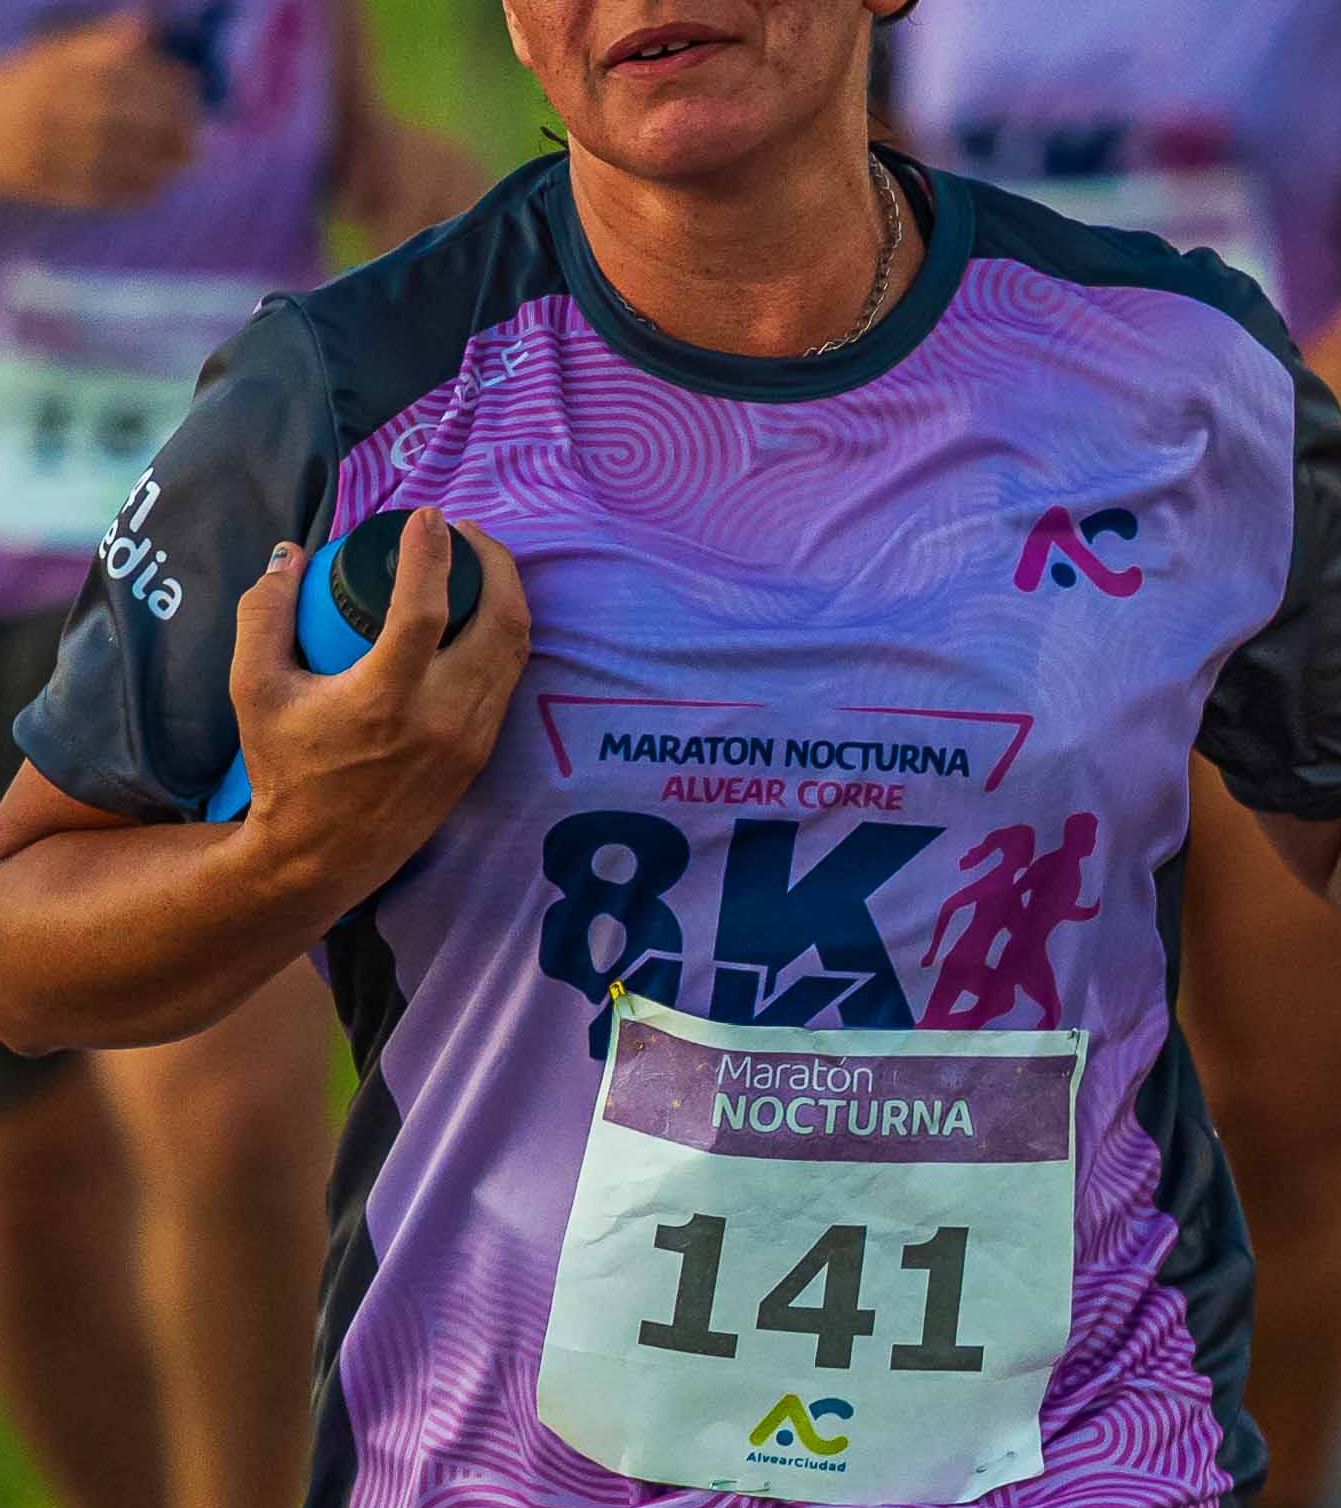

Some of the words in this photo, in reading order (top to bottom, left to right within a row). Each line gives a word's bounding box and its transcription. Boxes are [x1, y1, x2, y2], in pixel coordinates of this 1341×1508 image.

[598, 732, 774, 767] MARATON
[784, 738, 970, 777] NOCTURNA
[660, 775, 787, 808] ALVEAR
[797, 779, 905, 811] CORRE
[538, 810, 946, 1030] 8K
[717, 1055, 874, 1094] Maratón
[711, 1092, 975, 1137] NOCTURNA
[637, 1213, 985, 1373] 141
[745, 1451, 847, 1472] AlvearCiudad
